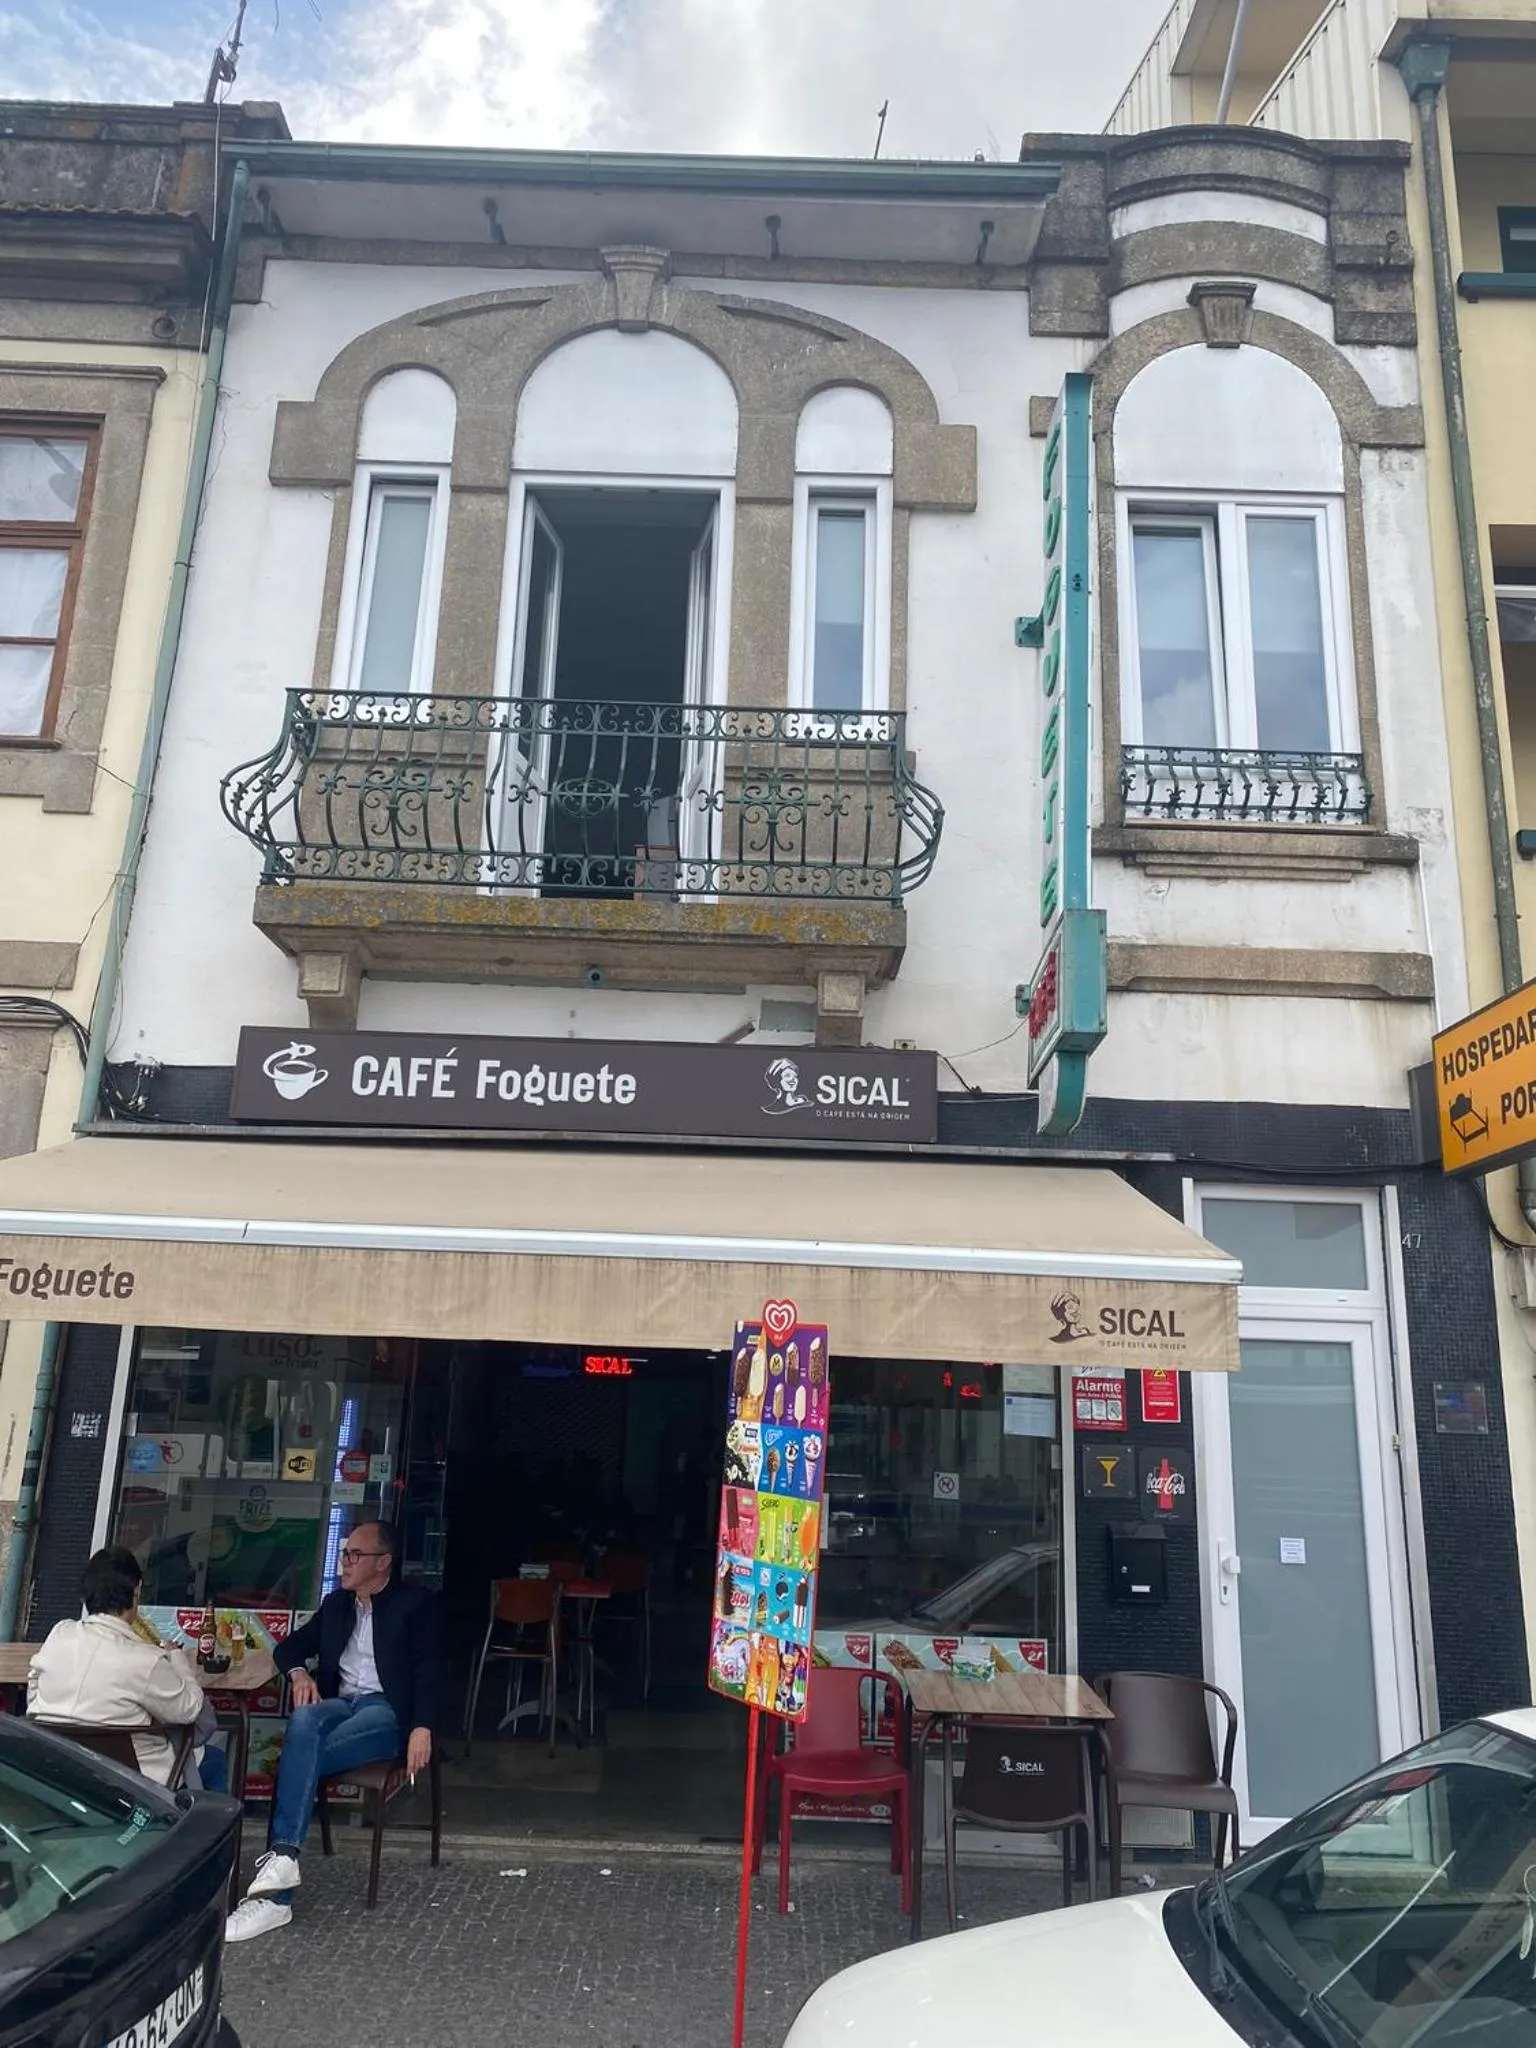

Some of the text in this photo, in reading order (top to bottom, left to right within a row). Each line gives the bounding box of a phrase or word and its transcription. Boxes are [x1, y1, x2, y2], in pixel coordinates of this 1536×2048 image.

[351, 1047, 637, 1106] CAFÉ Foguete
[816, 1075, 910, 1106] SICAL
[1402, 1233, 1421, 1249] 47
[1099, 1307, 1185, 1338] SICAL
[585, 1356, 632, 1374] SICAL
[1076, 1379, 1122, 1393] Alarme
[1016, 1762, 1044, 1772] SICAL
